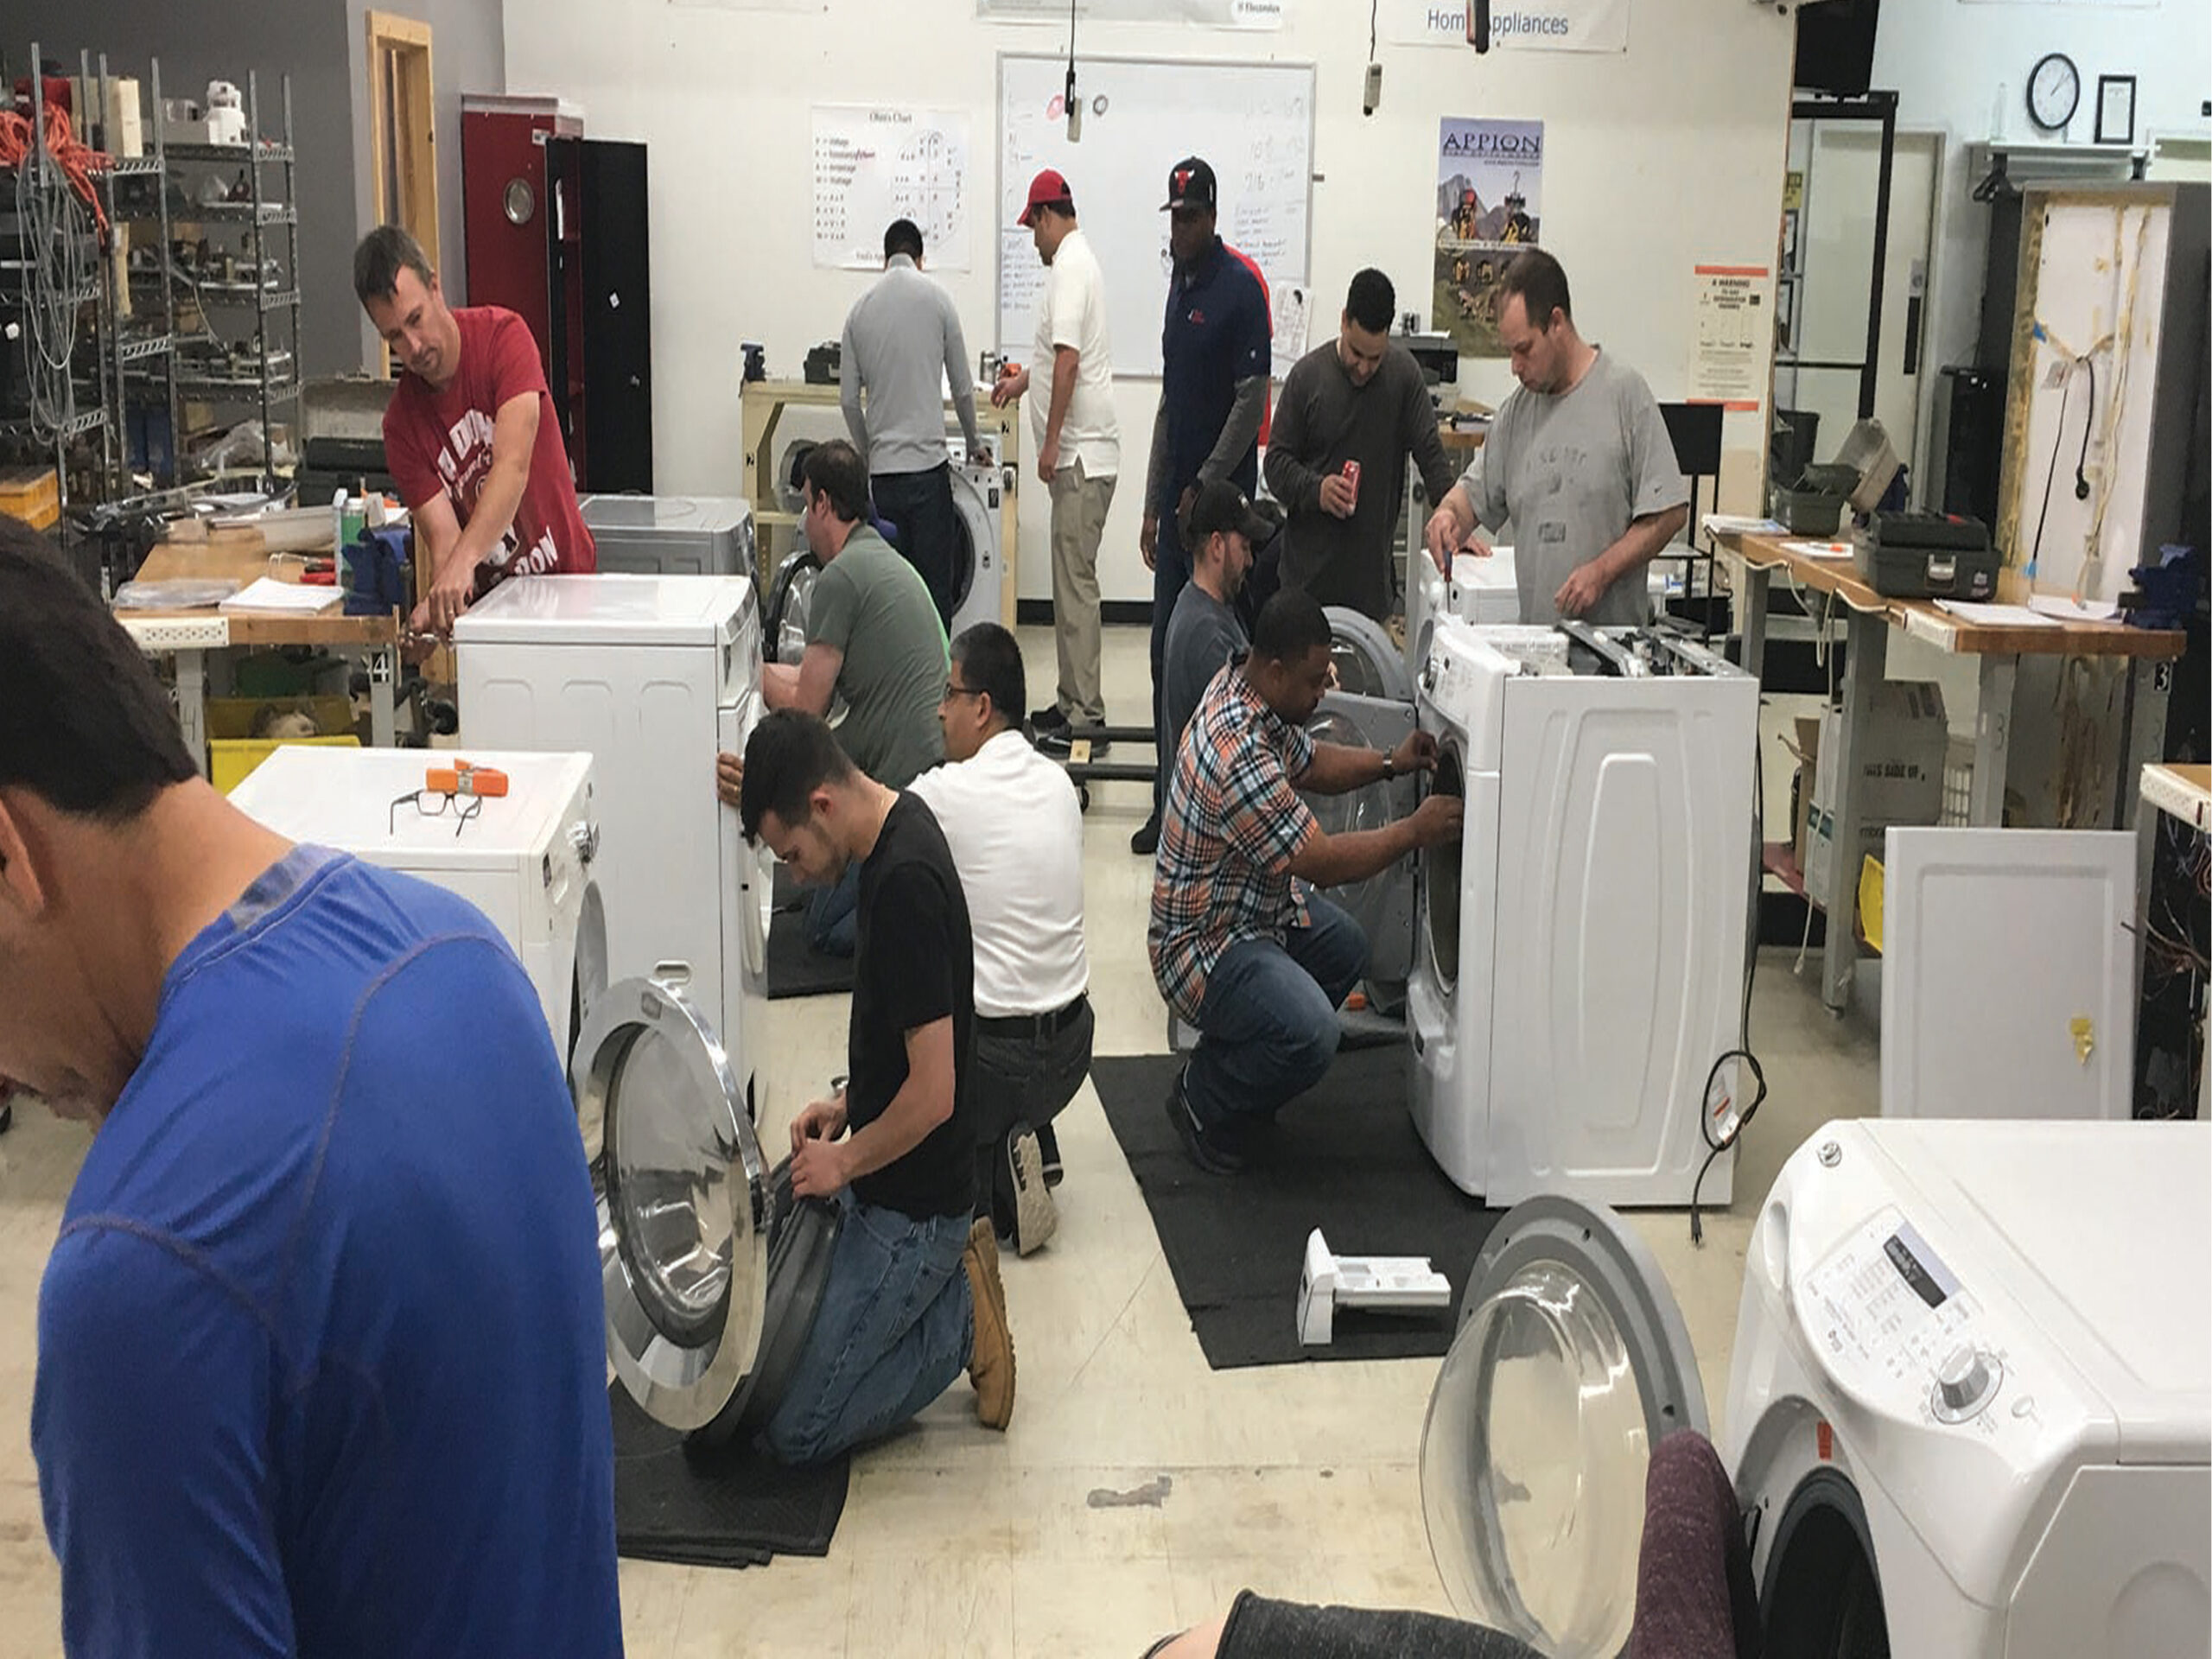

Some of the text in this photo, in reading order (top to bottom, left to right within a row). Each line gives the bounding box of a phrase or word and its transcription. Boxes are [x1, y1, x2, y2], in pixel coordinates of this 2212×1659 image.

[1427, 10, 1569, 35] Hom ppliances
[1443, 132, 1541, 153] APPION
[372, 653, 389, 683] 4
[2155, 662, 2169, 691] 3
[1995, 713, 2005, 751] 3
